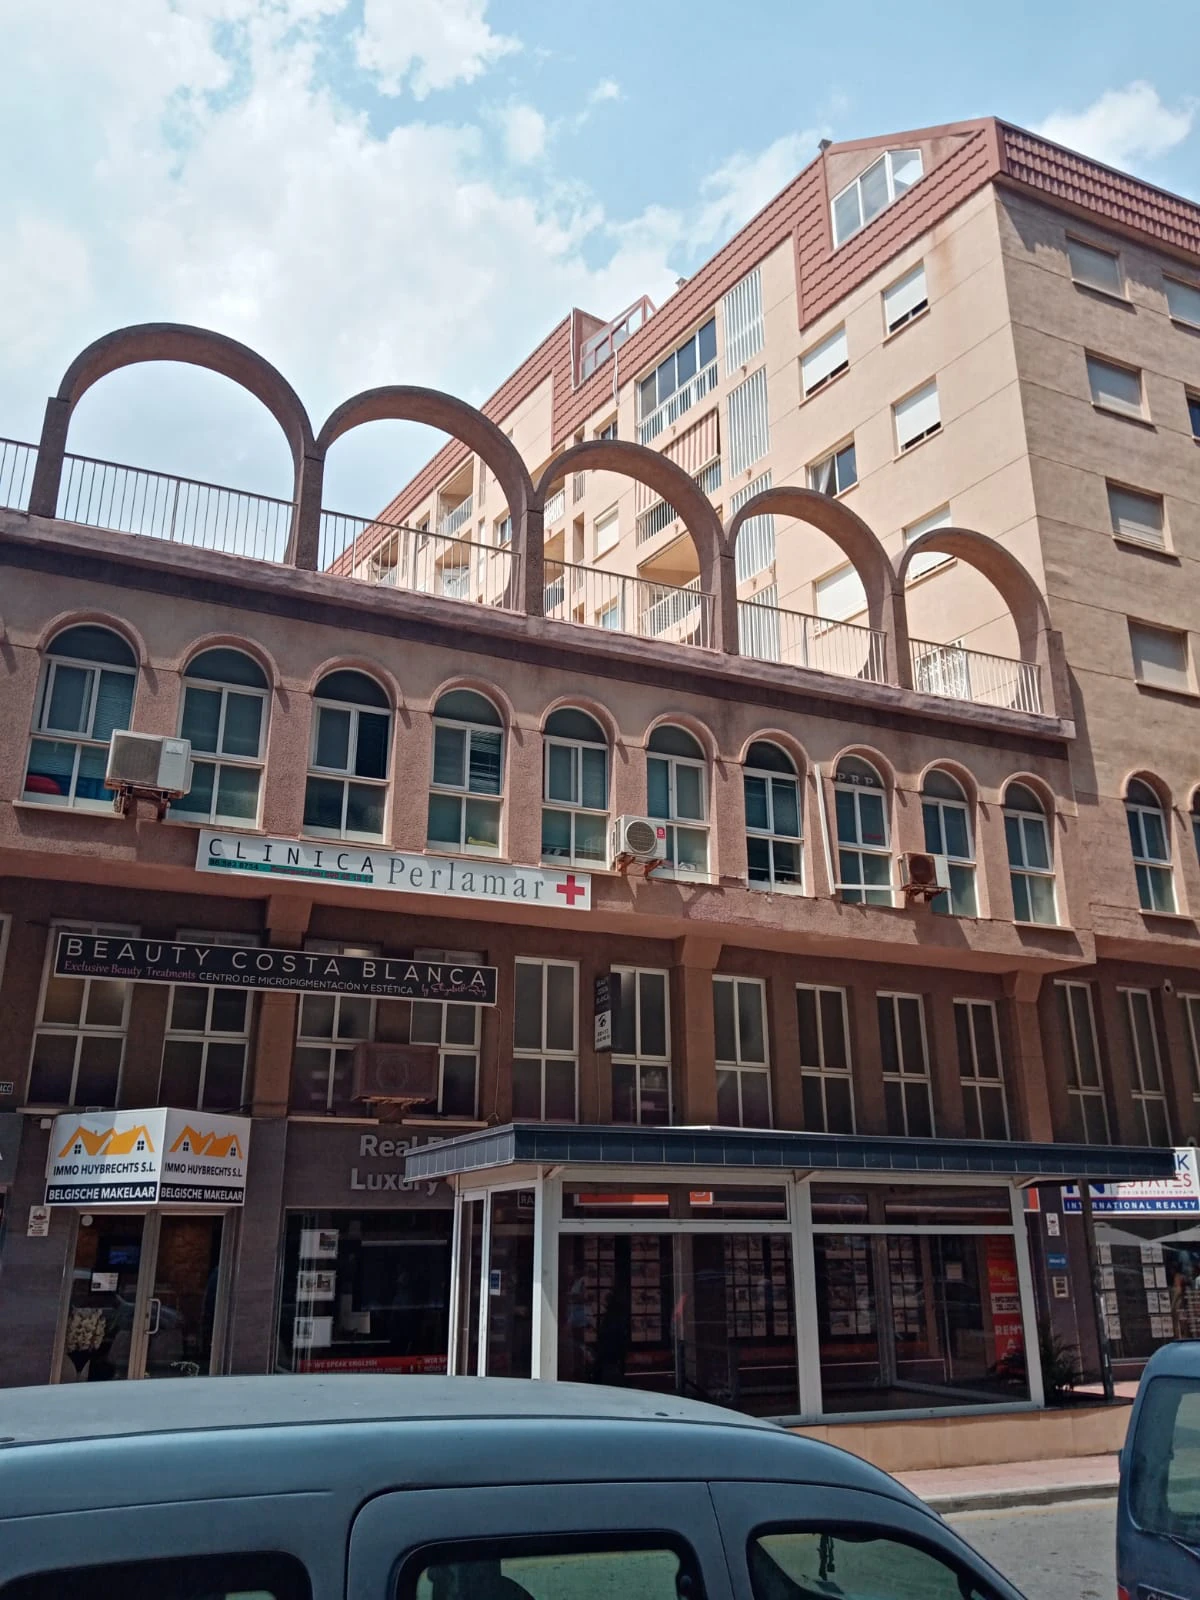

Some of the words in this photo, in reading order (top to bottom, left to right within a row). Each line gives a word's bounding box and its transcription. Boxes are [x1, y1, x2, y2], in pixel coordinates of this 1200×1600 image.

[209, 838, 374, 873] CLINICA
[387, 857, 544, 899] Perlamar
[64, 960, 109, 974] Exclusive
[111, 964, 142, 978] Beauty
[146, 967, 196, 980] Treatments
[66, 938, 211, 965] BEAUTY
[232, 952, 340, 976] COSTA
[363, 961, 486, 986] BLANCA
[199, 972, 240, 983] CENTRO
[242, 975, 256, 984] DE
[257, 976, 361, 991] MICROPIGMENTACIÓN
[370, 983, 413, 994] ESTÉTICA
[360, 1135, 418, 1157] Real
[53, 1165, 79, 1176] IMMO
[81, 1163, 139, 1175] HUYBRECHTS
[140, 1162, 156, 1173] S.L.
[164, 1162, 186, 1174] IMMO
[187, 1164, 231, 1177] HUYBRECHTS
[49, 1187, 99, 1200] BELGISCHE
[101, 1186, 155, 1199] MAKELAAR
[161, 1187, 202, 1200] BELGISCHE
[204, 1189, 243, 1201] MAKELAAR
[1066, 1201, 1151, 1209] INTRNATIONAL
[1156, 1200, 1196, 1209] REALTY
